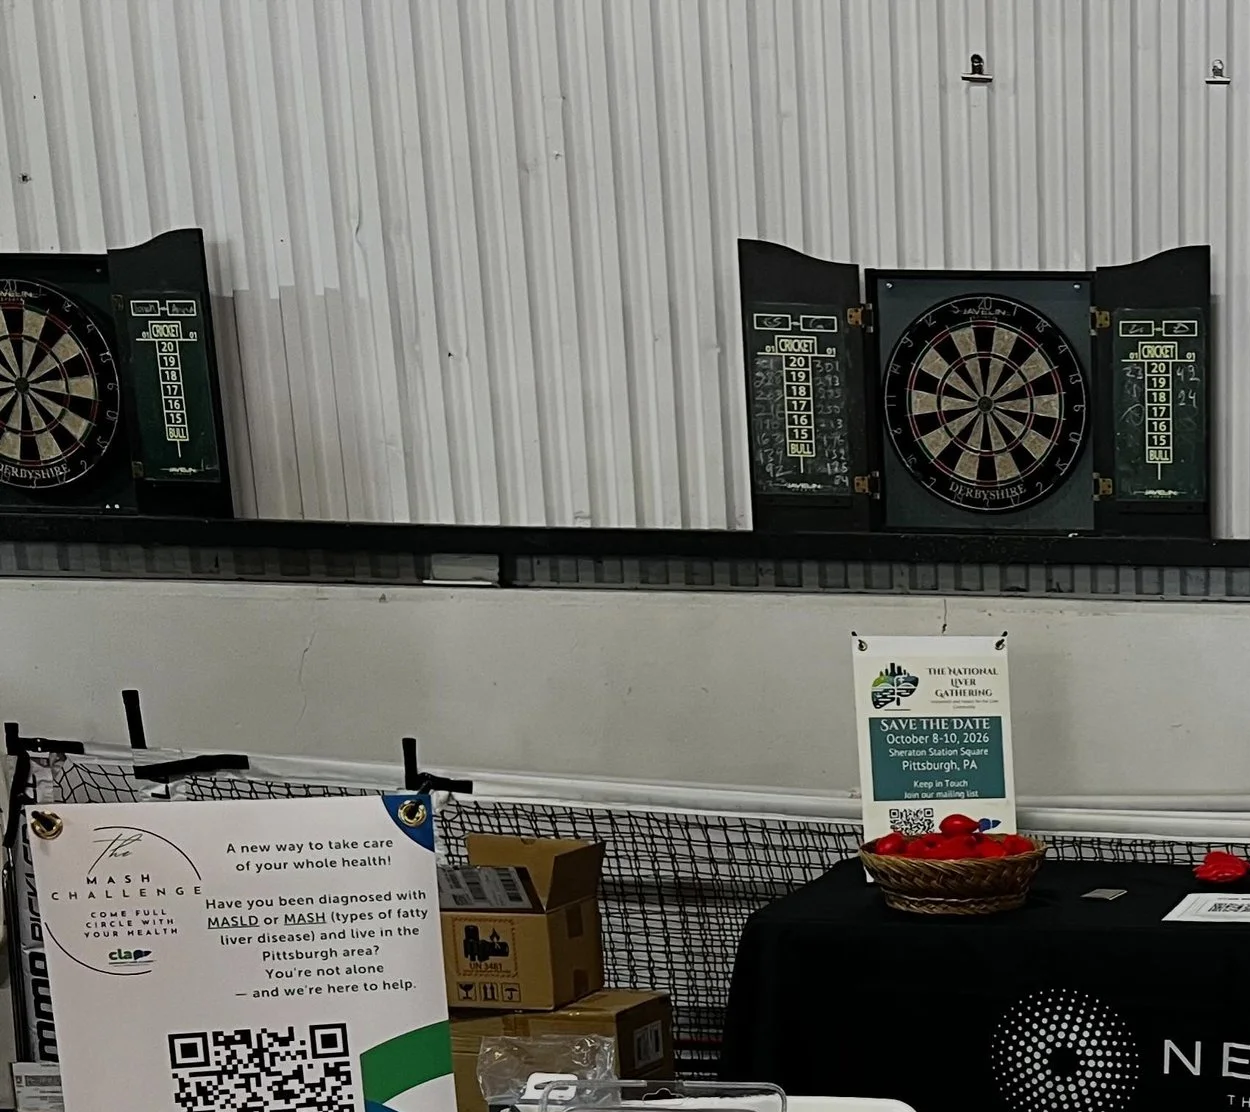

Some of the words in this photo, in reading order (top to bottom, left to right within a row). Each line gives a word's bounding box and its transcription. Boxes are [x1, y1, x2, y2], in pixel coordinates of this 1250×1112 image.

[152, 325, 178, 337] CRICKET
[162, 342, 173, 352] 20
[779, 339, 814, 352] CRICKET
[1142, 345, 1174, 358] CRICKET
[163, 357, 175, 366] 19
[790, 357, 804, 367] 20
[1151, 363, 1165, 373] 20
[165, 371, 177, 380] 18
[791, 371, 805, 381] 19
[1152, 378, 1166, 388] 19
[166, 385, 178, 395] 17
[791, 386, 806, 396] 18
[1152, 392, 1166, 403] 18
[169, 400, 180, 409] 16
[792, 401, 806, 410] 17
[1152, 407, 1166, 417] 17
[170, 414, 181, 423] 15
[793, 415, 807, 425] 16
[1153, 421, 1166, 432] 16
[169, 428, 185, 438] BULL
[794, 430, 808, 439] 15
[1153, 436, 1166, 446] 15
[791, 444, 812, 454] BULL
[1150, 450, 1169, 461] BULL
[949, 481, 1027, 500] DERBYSHIRE
[928, 667, 946, 675] THE
[949, 667, 998, 676] NATIONAL
[951, 679, 976, 687] LIVER
[935, 689, 992, 698] GATHERING
[880, 719, 917, 731] SAVE
[923, 719, 949, 730] THE
[953, 718, 990, 730] DATE
[887, 733, 929, 744] October
[933, 733, 960, 745] 8-10,
[963, 733, 989, 743] 2026
[889, 748, 927, 757] Sheraton
[929, 748, 958, 757] Station
[960, 748, 989, 757] Square
[902, 761, 960, 772] Pittsburgh,
[963, 760, 977, 769] PA
[914, 780, 933, 789] Keep
[946, 779, 968, 787] Touch
[904, 791, 919, 799] Join
[936, 790, 965, 799] mailing
[967, 789, 979, 797] list
[227, 843, 235, 853] A
[241, 843, 270, 853] new
[276, 842, 304, 854] way
[310, 841, 323, 850] to
[328, 839, 358, 850] take
[363, 839, 393, 848] care
[236, 861, 251, 871] of
[256, 861, 288, 873] your
[293, 858, 337, 869] whole
[342, 856, 391, 867] health!
[86, 874, 149, 884] MASH
[51, 886, 201, 900] CHALLENGE
[206, 899, 242, 909] Have
[247, 897, 273, 910] you
[279, 896, 314, 906] been
[319, 891, 391, 906] diagnosed
[396, 890, 426, 900] with
[208, 915, 259, 928] MASLD
[264, 916, 278, 925] or
[284, 912, 326, 925] MASH
[331, 911, 373, 923] (types
[378, 909, 392, 919] of
[397, 908, 428, 920] fatty
[86, 920, 132, 928] CIRCLE
[128, 928, 177, 936] HEALTH
[220, 935, 252, 945] liver
[257, 930, 315, 943] disease)
[320, 929, 346, 940] and
[351, 928, 375, 939] live
[380, 927, 393, 937] in
[398, 926, 419, 936] the
[262, 948, 338, 961] Pittsburgh
[343, 945, 380, 957] area?
[265, 968, 312, 979] You're
[316, 966, 340, 976] not
[345, 964, 384, 975] alone
[253, 987, 278, 998] and
[284, 985, 322, 996] we're
[327, 984, 359, 994] here
[364, 982, 378, 991] to
[383, 979, 416, 992] help.
